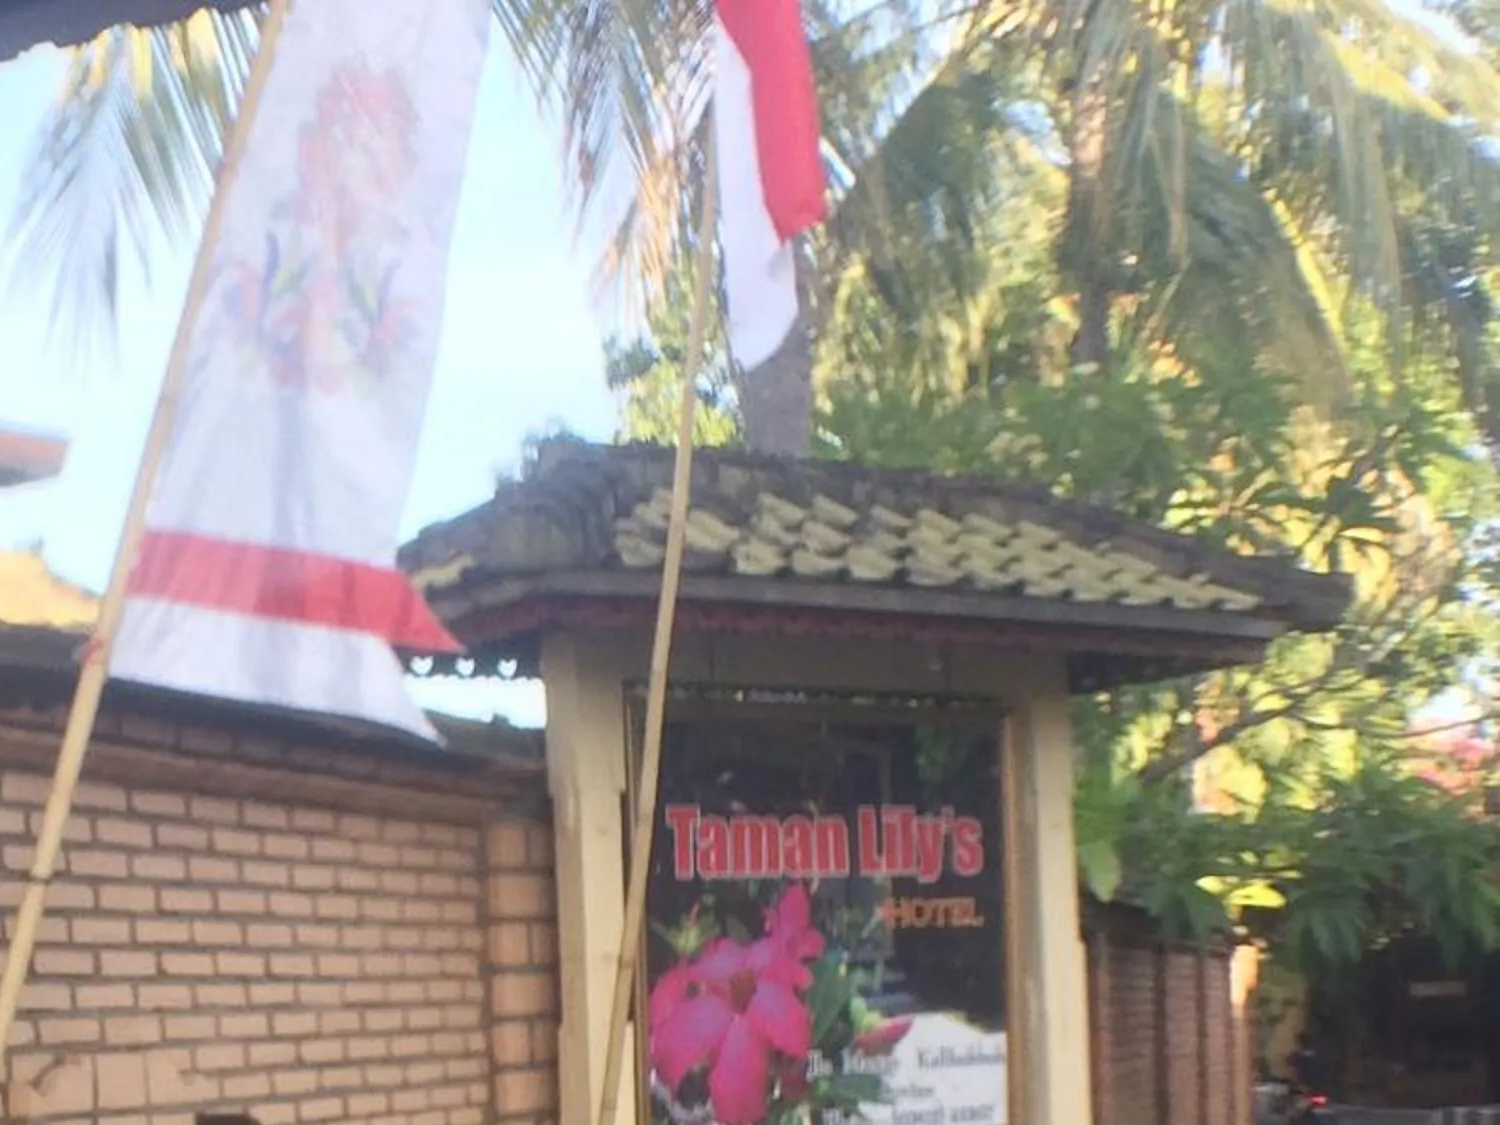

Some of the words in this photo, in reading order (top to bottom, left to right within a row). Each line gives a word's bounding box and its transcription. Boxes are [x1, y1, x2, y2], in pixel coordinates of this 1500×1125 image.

[666, 806, 850, 880] Taman
[857, 806, 984, 884] Lily's
[886, 897, 985, 929] HOTEL
